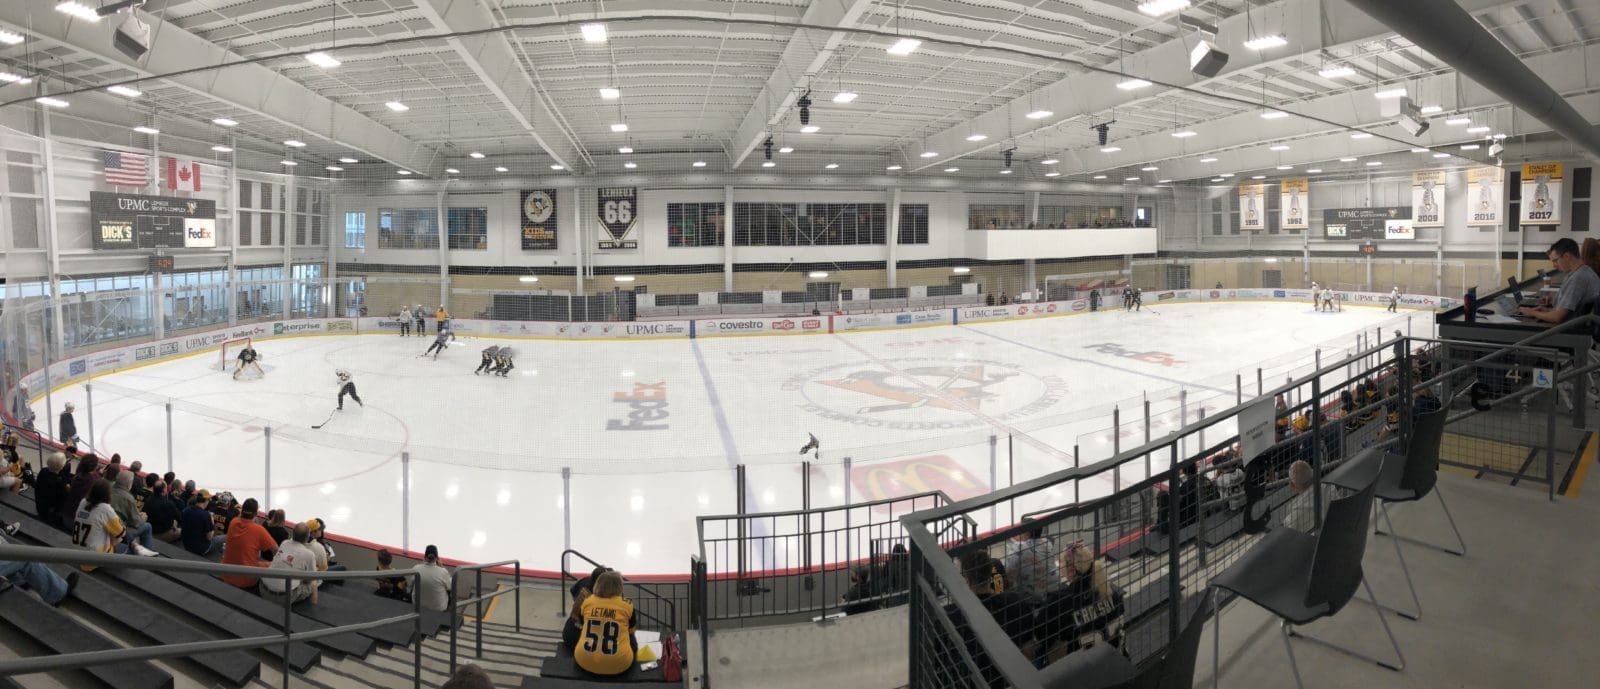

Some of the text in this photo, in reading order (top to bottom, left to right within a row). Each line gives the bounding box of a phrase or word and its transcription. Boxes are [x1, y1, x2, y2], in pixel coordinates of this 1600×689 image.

[602, 188, 633, 197] LEMIEUX
[118, 198, 149, 211] UPMC
[605, 201, 631, 223] 66
[1418, 214, 1438, 222] 2009
[1474, 213, 1496, 221] 2016
[1529, 212, 1552, 220] 2017
[102, 225, 132, 240] DICK'S
[188, 227, 212, 240] FedEx
[1389, 226, 1410, 234] FedEx
[964, 309, 991, 319] UPMC
[626, 324, 665, 335] UPMC
[720, 320, 764, 330] covestro
[186, 335, 211, 350] UPMC
[1505, 363, 1522, 384] 4
[606, 381, 669, 431] FedEx
[72, 521, 92, 547] 87
[591, 607, 617, 620] LETANG
[584, 620, 620, 656] 58
